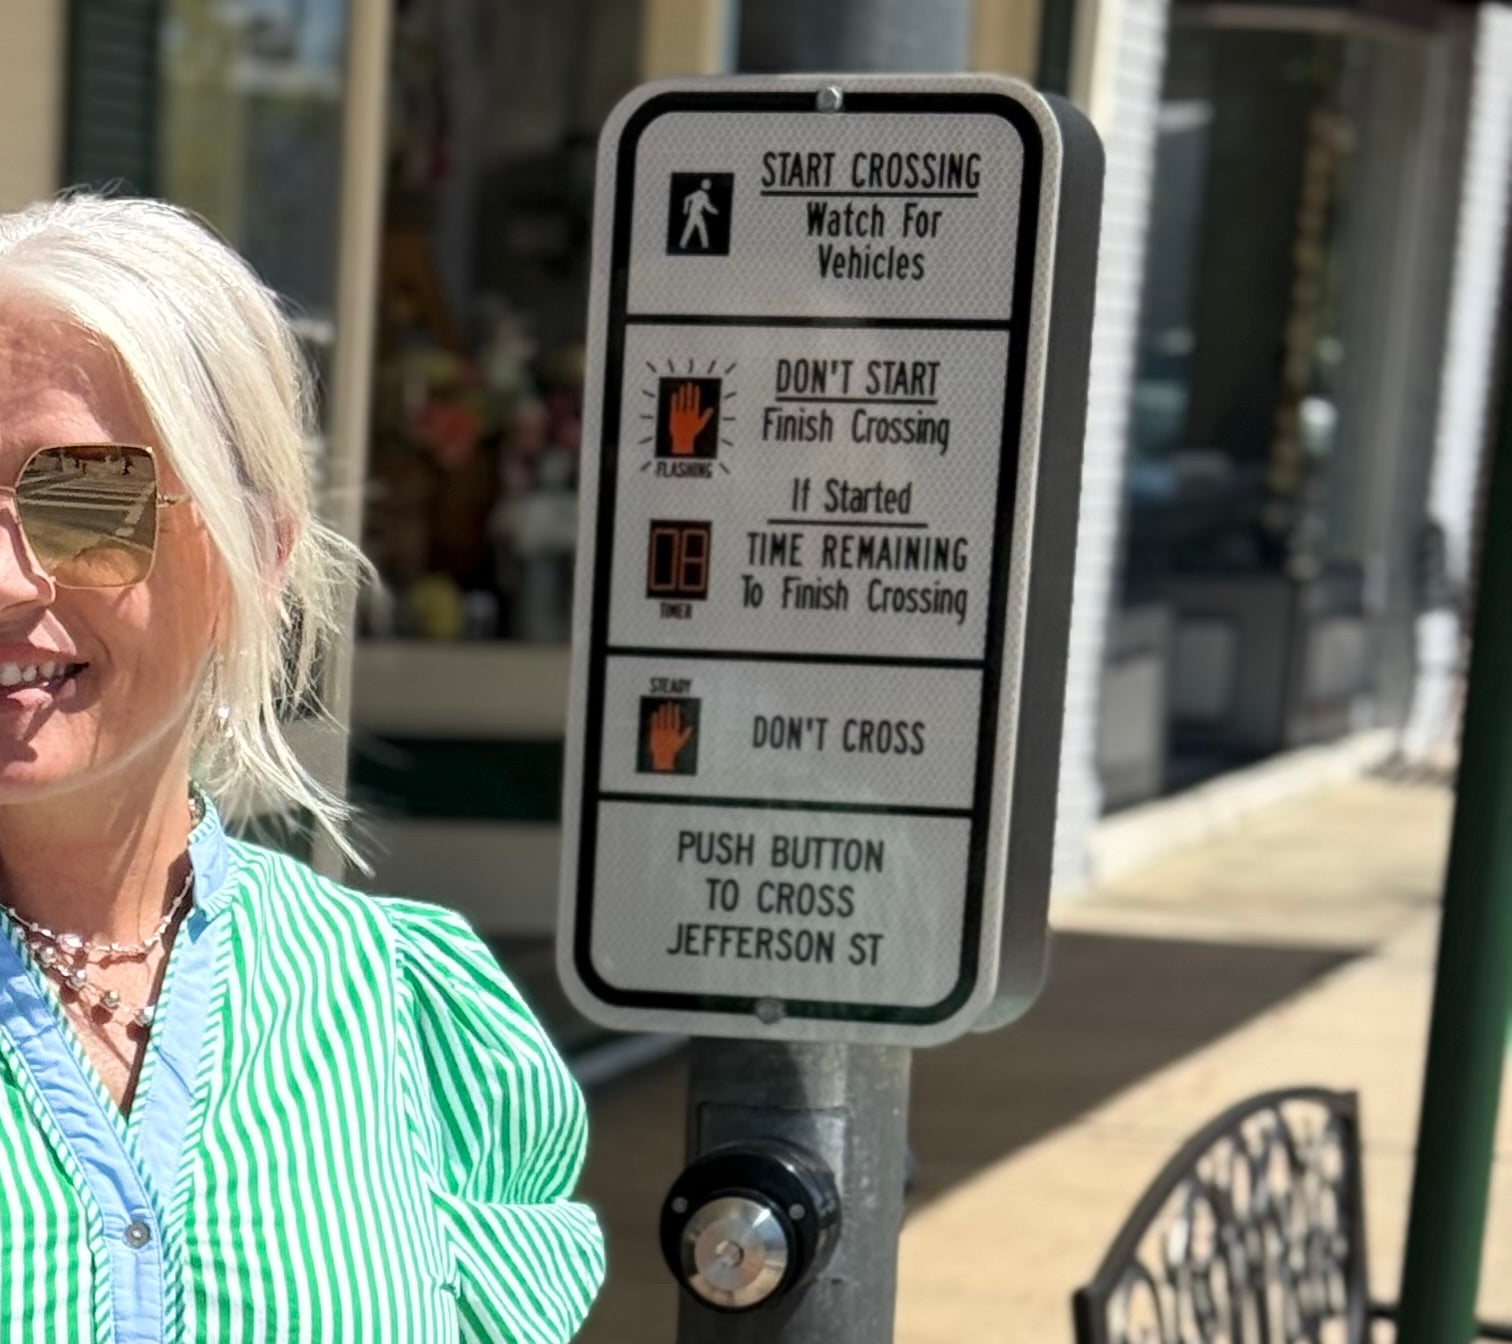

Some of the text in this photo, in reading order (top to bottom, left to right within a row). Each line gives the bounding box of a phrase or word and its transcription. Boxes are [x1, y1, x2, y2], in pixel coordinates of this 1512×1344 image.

[760, 151, 982, 189] START CROSSING
[806, 201, 943, 239] Watch For
[817, 244, 926, 282] Vehicles
[774, 358, 941, 396] DON'T START
[761, 406, 952, 456] Finish Crossing
[654, 460, 714, 480] FLASHING
[790, 477, 913, 515] If Started
[746, 531, 969, 573] TIME REMAINING
[741, 574, 969, 626] To Finish Crossing
[751, 715, 926, 756] DON'T CROSS
[676, 830, 885, 873] PUSH BUTTON
[705, 877, 855, 918] TO CROSS
[666, 922, 885, 967] JEFFERSON ST
